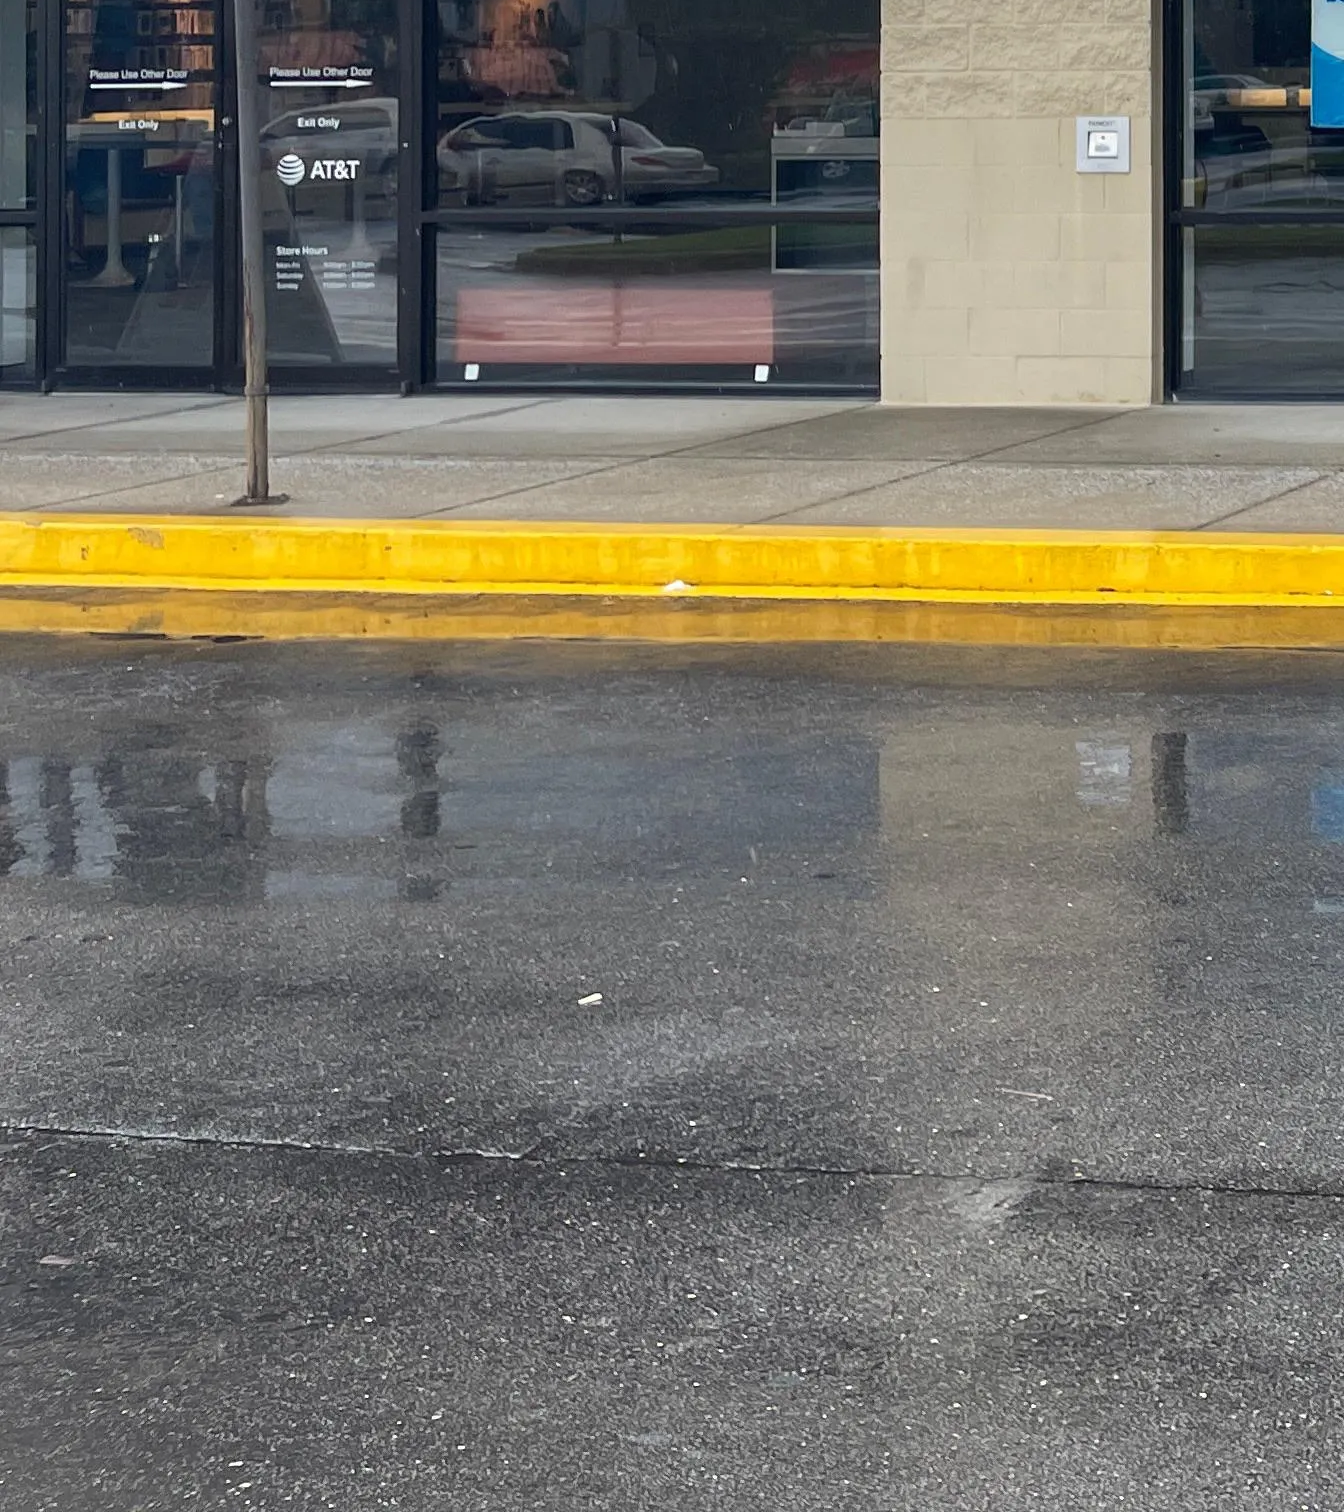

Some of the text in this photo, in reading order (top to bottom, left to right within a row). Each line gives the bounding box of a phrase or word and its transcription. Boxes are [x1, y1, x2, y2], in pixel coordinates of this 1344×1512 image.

[89, 69, 188, 79] Please Use Other Door
[269, 66, 373, 77] Please Use Other Door
[118, 119, 159, 131] Exit Only
[297, 117, 340, 129] Exit Only
[310, 160, 360, 180] AT&T
